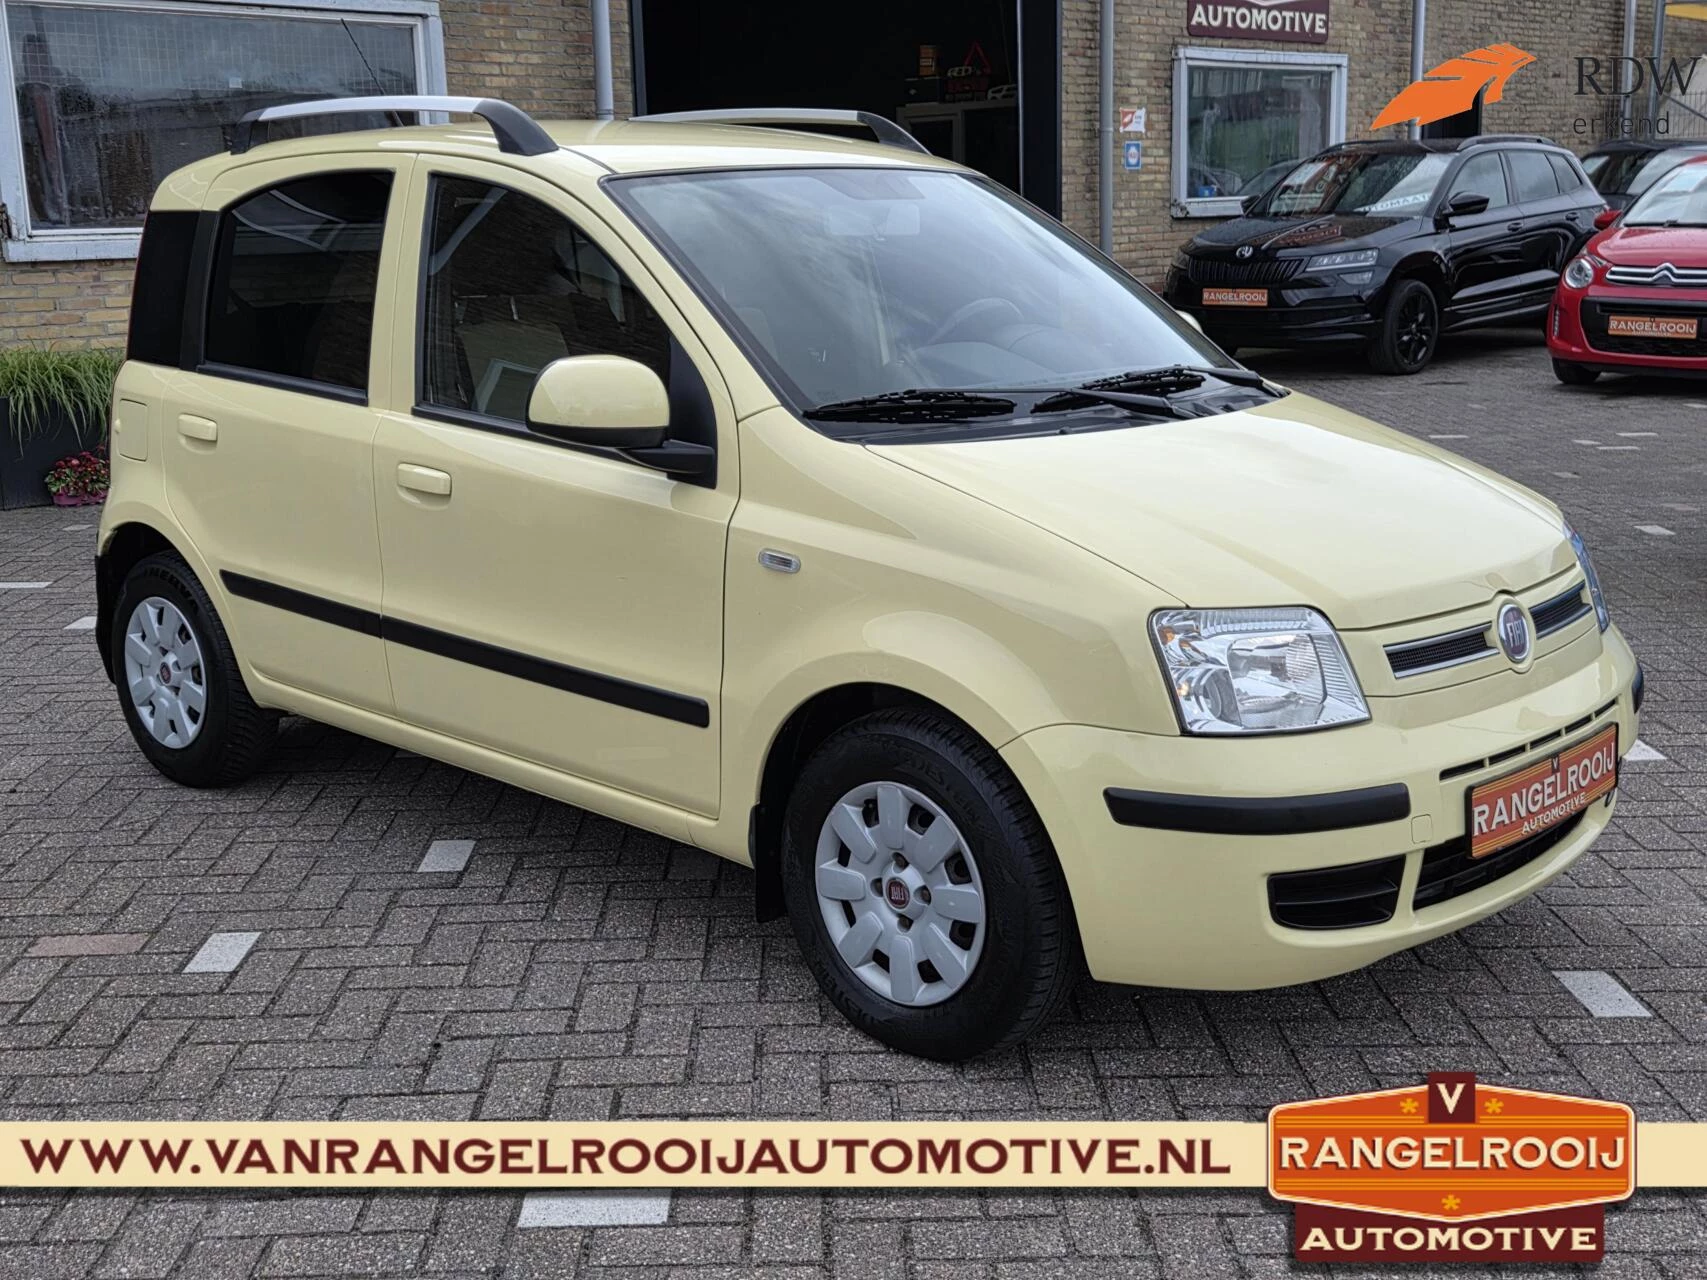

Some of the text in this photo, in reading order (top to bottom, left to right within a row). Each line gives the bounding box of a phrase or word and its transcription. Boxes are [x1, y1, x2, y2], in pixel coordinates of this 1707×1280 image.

[1190, 3, 1327, 34] AUTOMOTIVE
[1359, 193, 1428, 212] UTOMAAT
[1203, 292, 1267, 302] RANGELROOIJ
[1609, 320, 1696, 333] RANGELROOIJ
[1506, 619, 1525, 648] FIAT
[1552, 757, 1559, 770] V
[1473, 741, 1615, 836] RANGELROOIJ
[1521, 791, 1586, 835] AUTOMOTIVE
